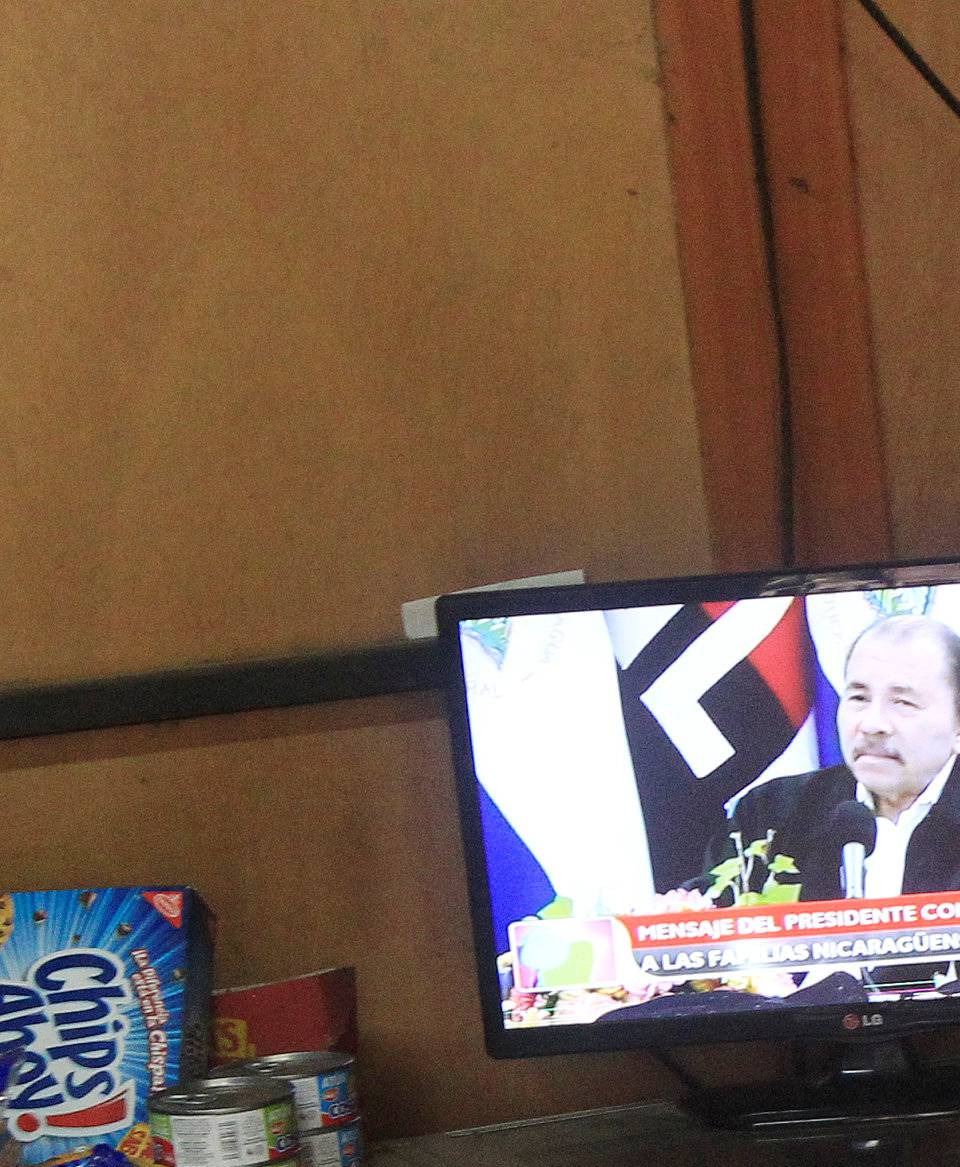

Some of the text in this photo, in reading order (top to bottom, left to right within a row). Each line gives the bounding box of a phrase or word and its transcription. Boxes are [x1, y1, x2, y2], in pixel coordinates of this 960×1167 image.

[637, 918, 735, 942] MENSAJE
[736, 915, 782, 934] DEL
[783, 904, 917, 931] PRESIDENTE
[640, 957, 660, 974] A
[662, 951, 706, 971] LAS
[707, 943, 810, 967] FALIAS
[34, 952, 127, 1100] Chips
[862, 1013, 883, 1027] LG
